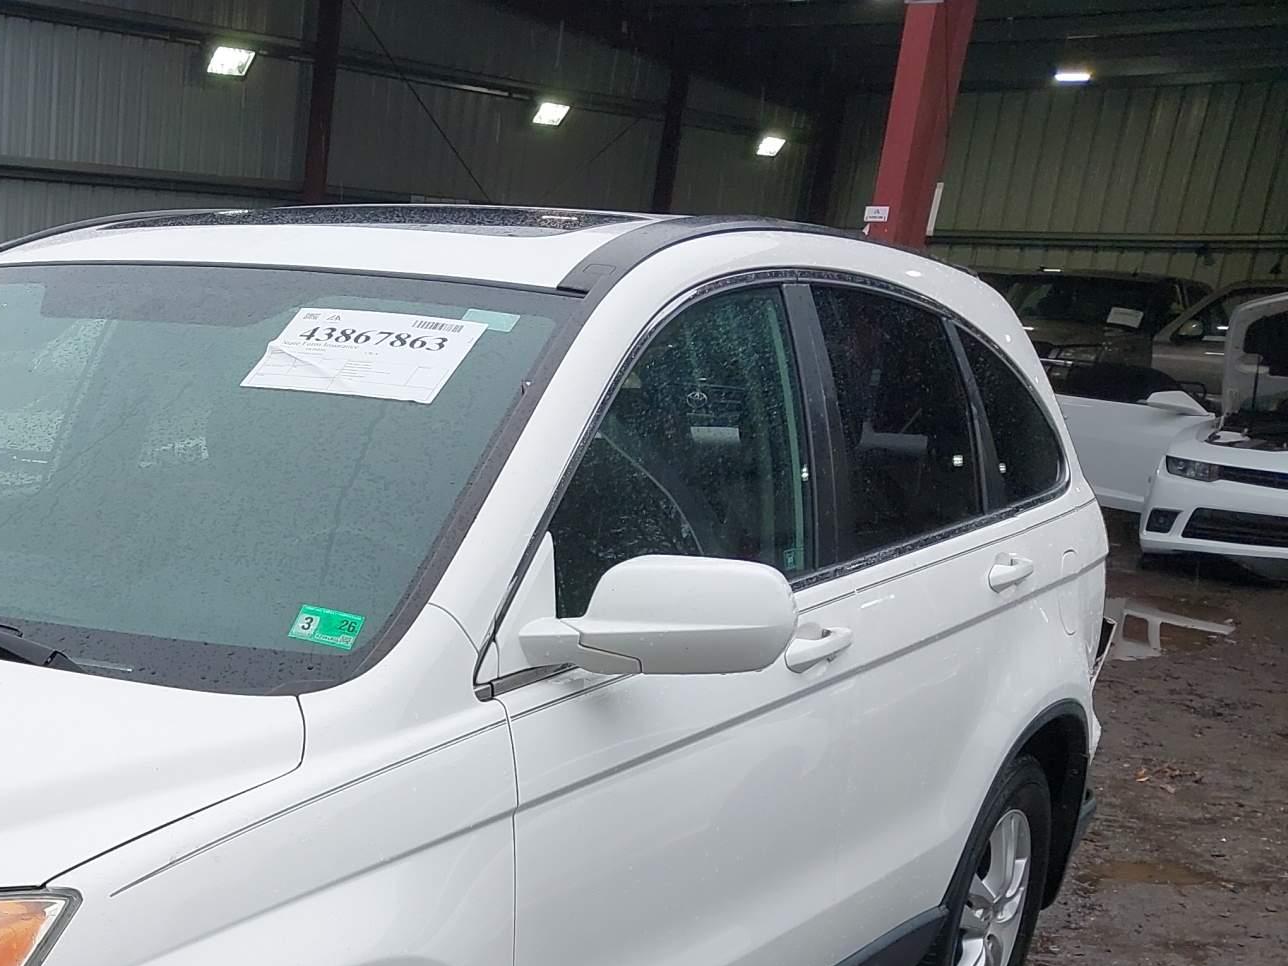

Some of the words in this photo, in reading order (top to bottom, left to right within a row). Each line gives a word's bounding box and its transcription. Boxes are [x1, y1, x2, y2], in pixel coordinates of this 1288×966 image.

[299, 326, 449, 352] 43867863
[301, 616, 314, 631] 3
[338, 620, 358, 633] 26
